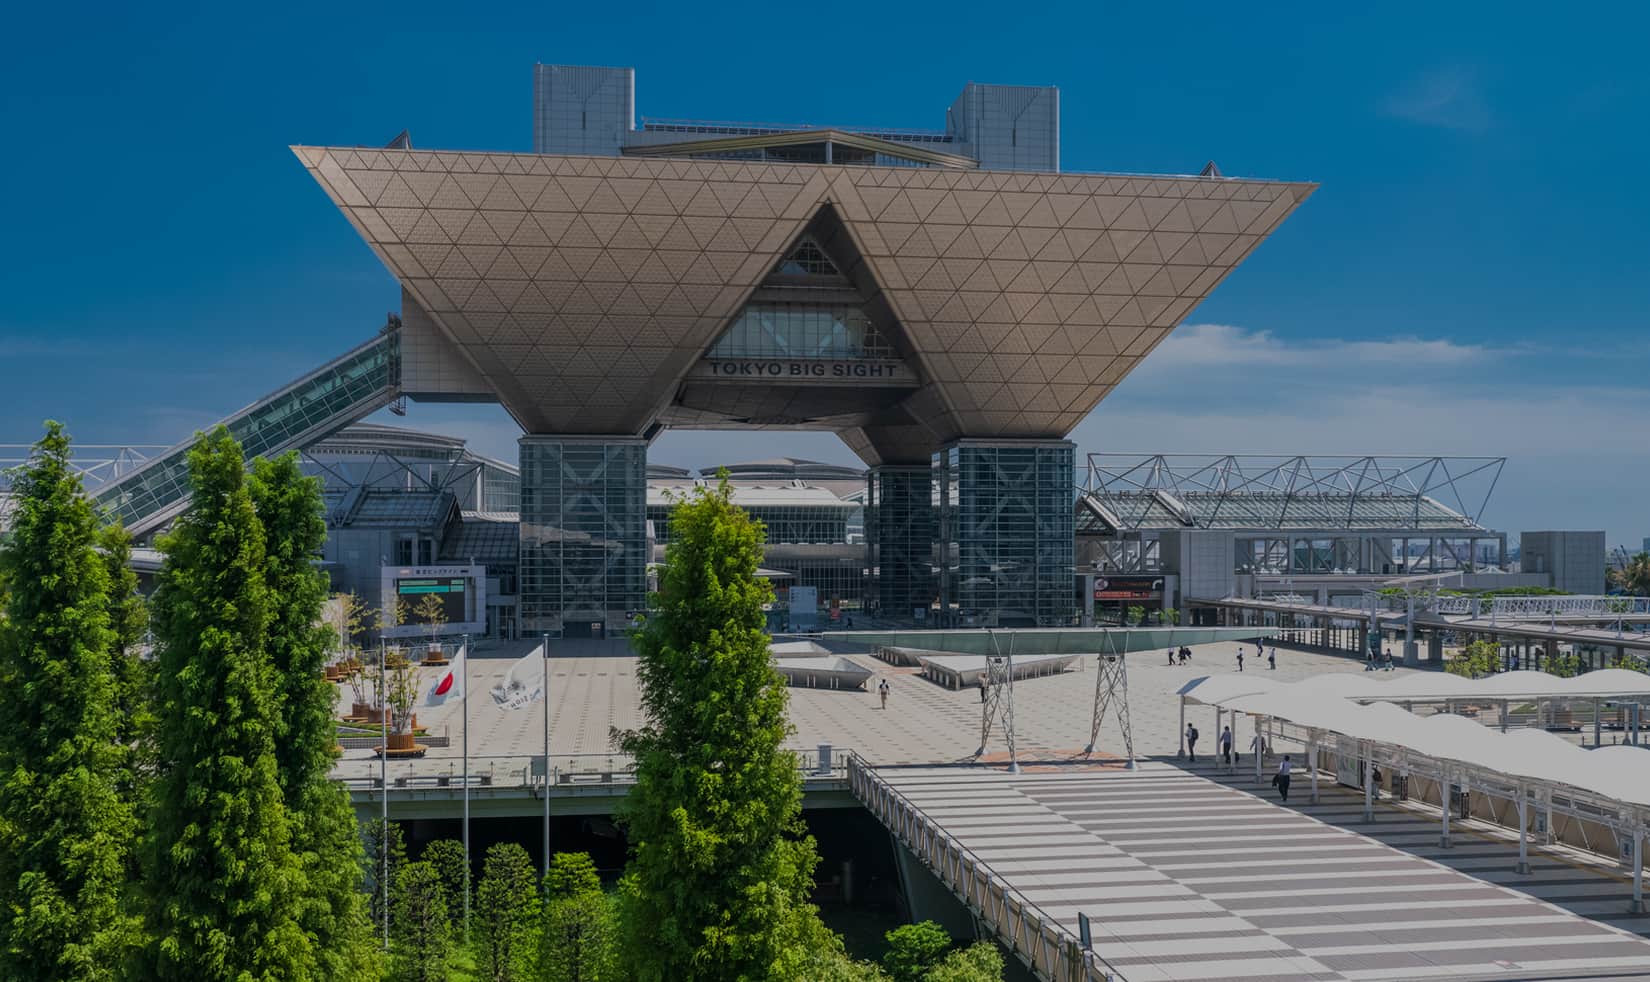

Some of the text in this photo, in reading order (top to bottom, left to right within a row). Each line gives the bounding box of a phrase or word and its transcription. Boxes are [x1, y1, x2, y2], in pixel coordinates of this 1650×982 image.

[711, 362, 897, 377] TOKYO BIG SIGHT
